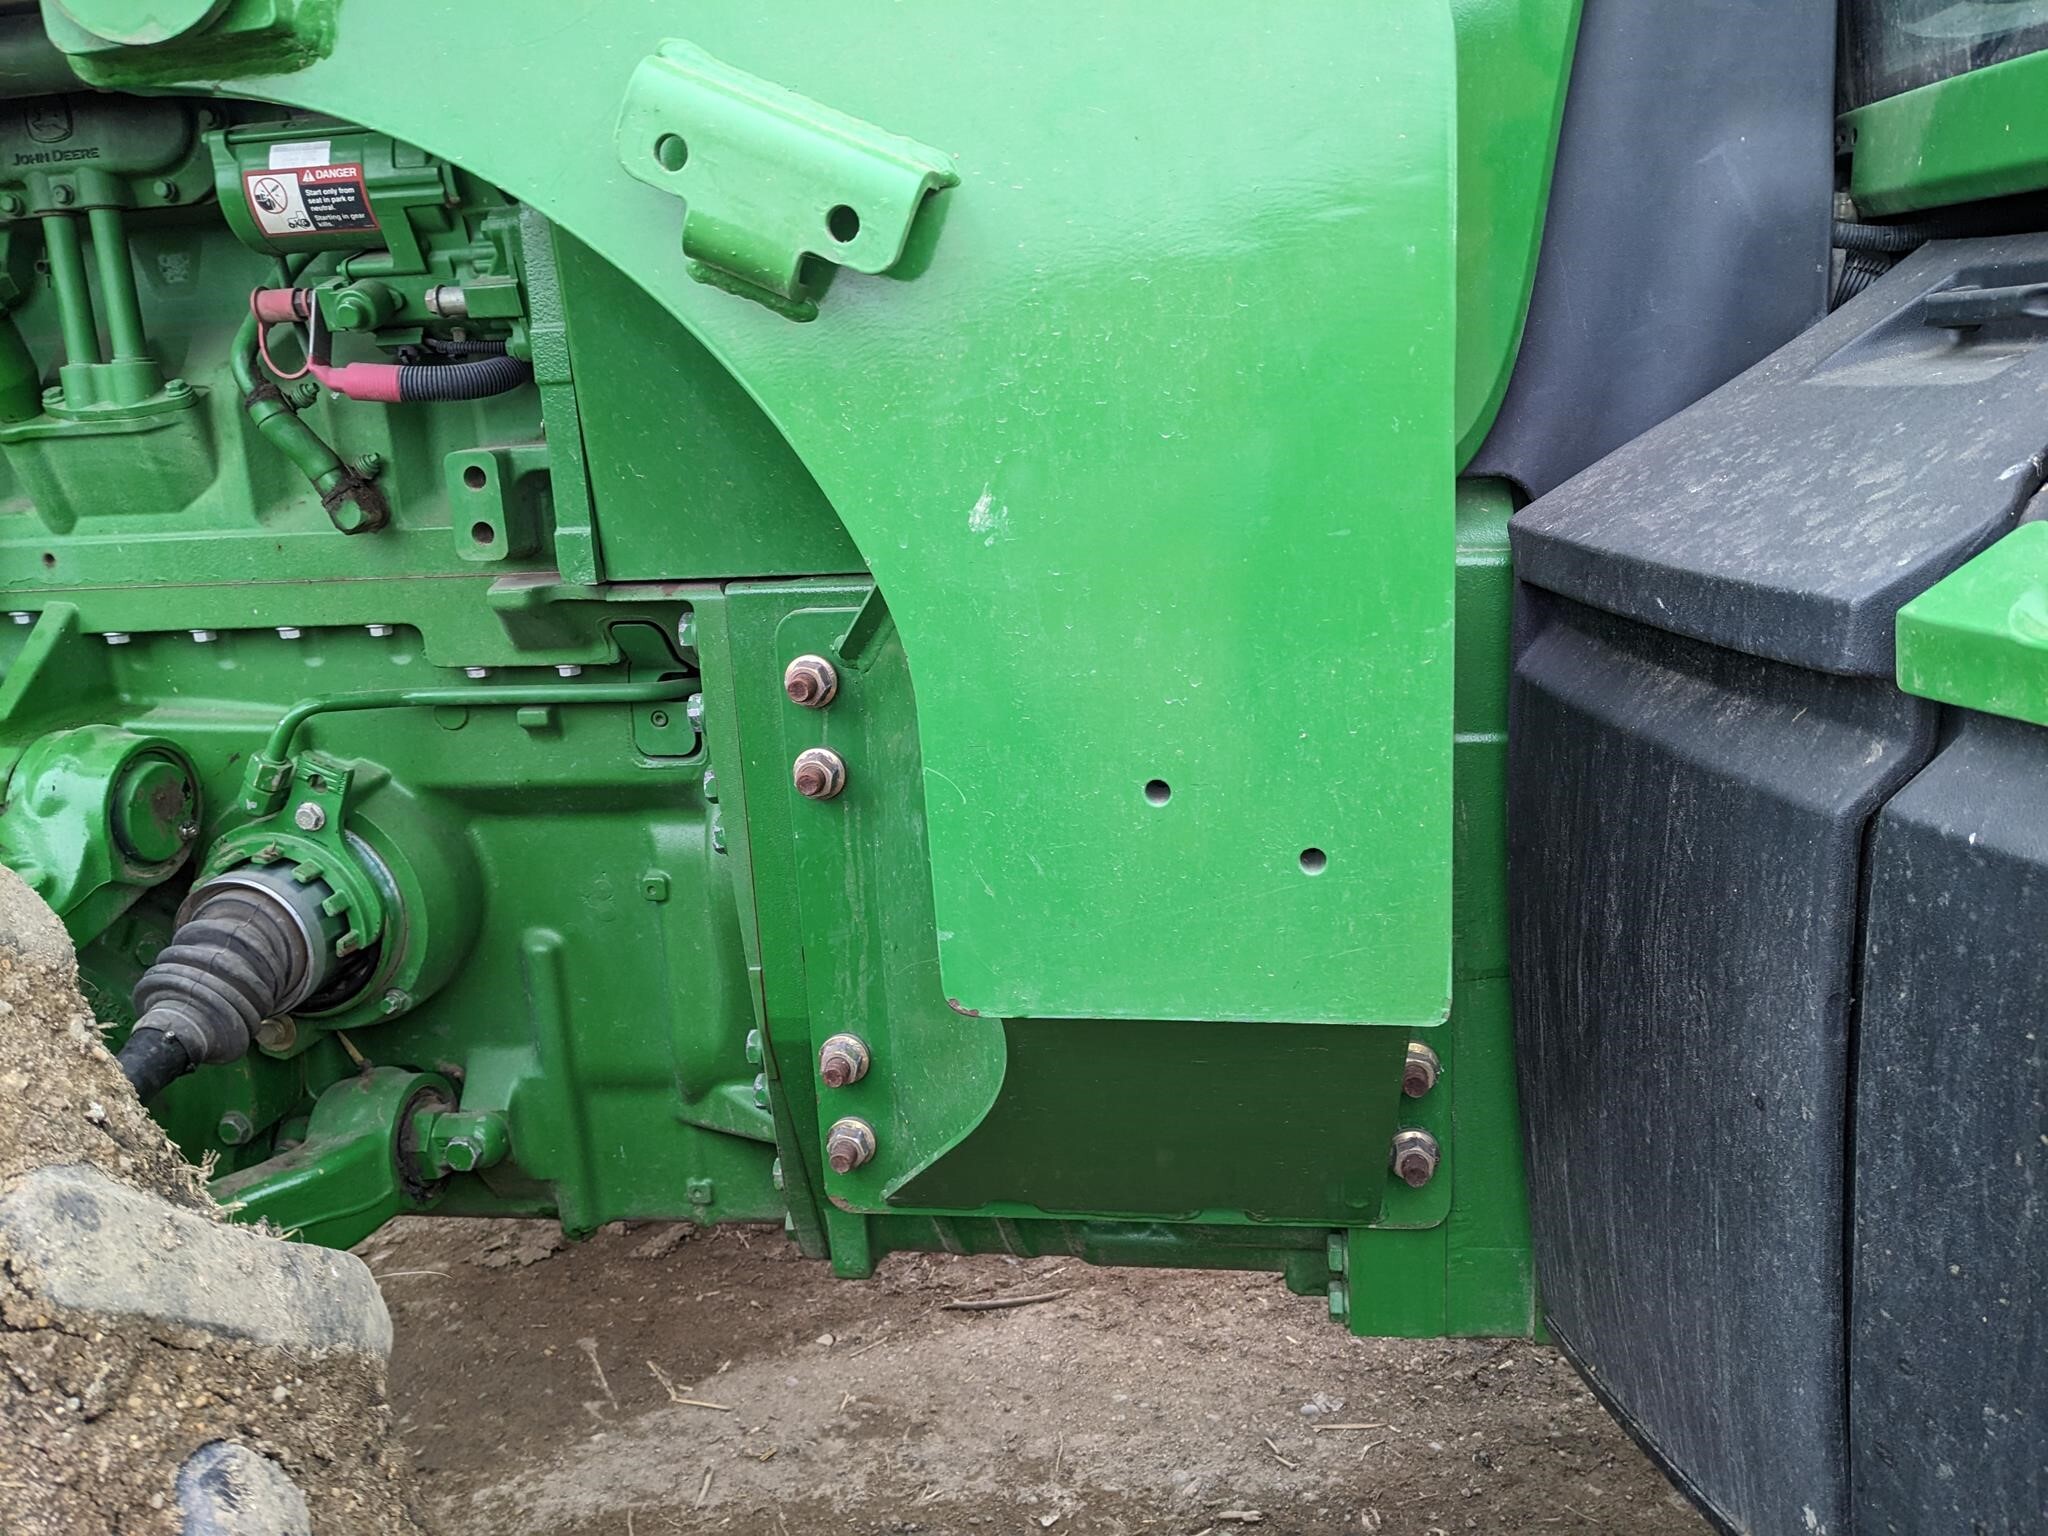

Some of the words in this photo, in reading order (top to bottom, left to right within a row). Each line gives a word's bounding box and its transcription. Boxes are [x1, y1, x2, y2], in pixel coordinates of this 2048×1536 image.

[13, 153, 50, 166] JOHN
[52, 147, 100, 162] DEERE
[315, 167, 357, 180] DANGER
[322, 188, 338, 196] only
